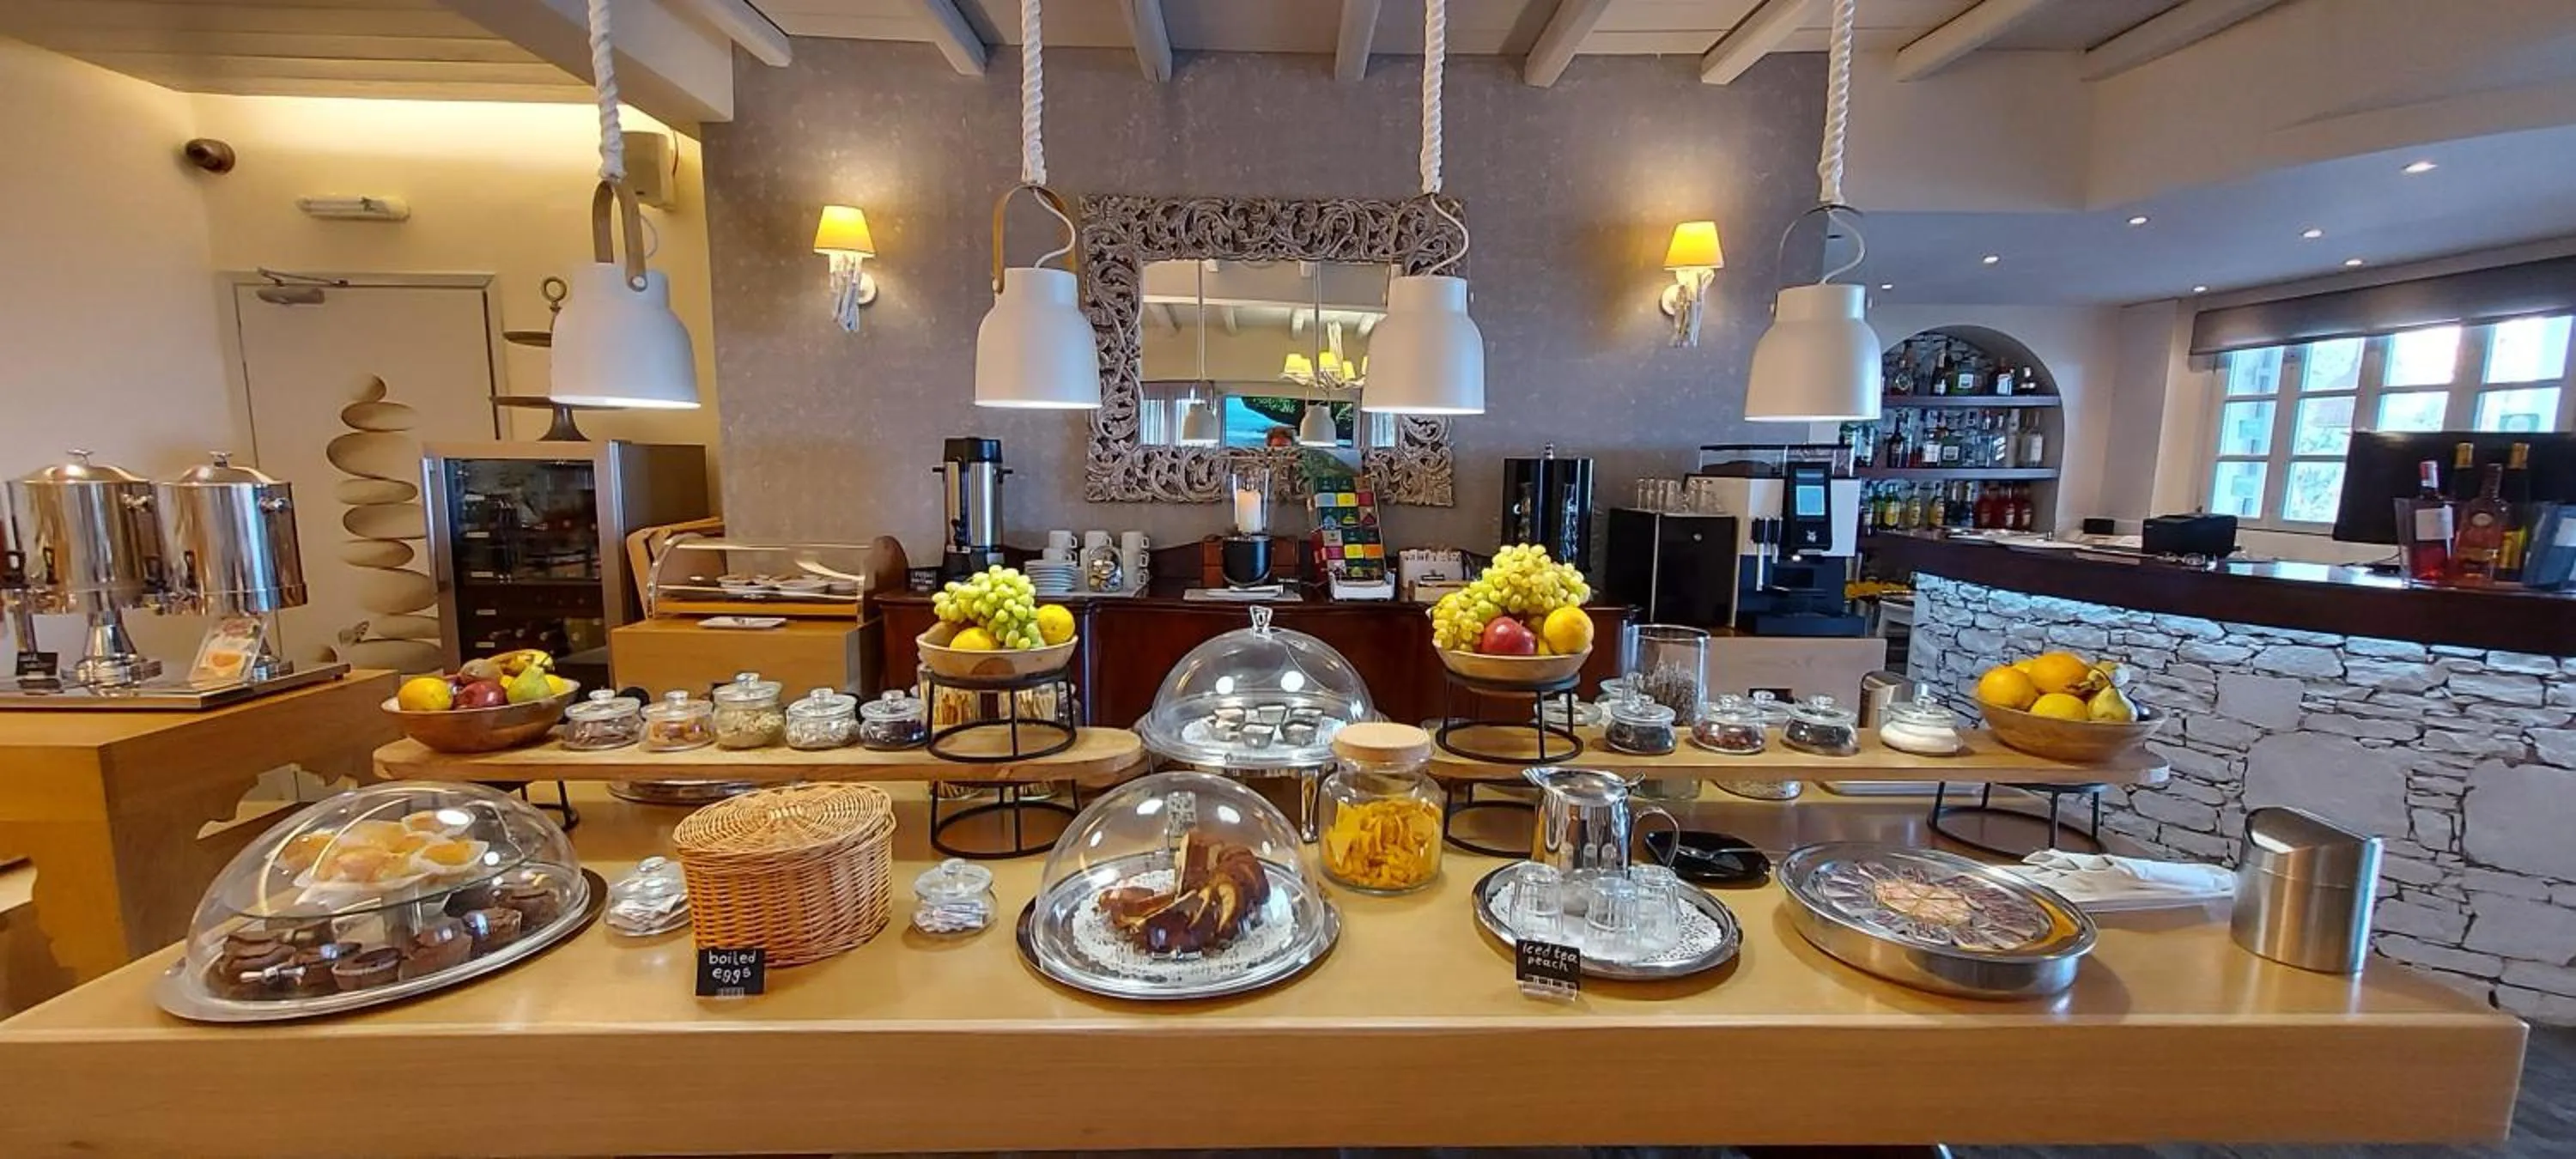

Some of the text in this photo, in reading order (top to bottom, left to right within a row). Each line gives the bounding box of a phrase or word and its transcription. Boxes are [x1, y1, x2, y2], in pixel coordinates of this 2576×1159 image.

[708, 950, 756, 965] boiled
[1553, 947, 1577, 963] tea
[1527, 956, 1569, 972] peach
[712, 967, 751, 985] eggs
